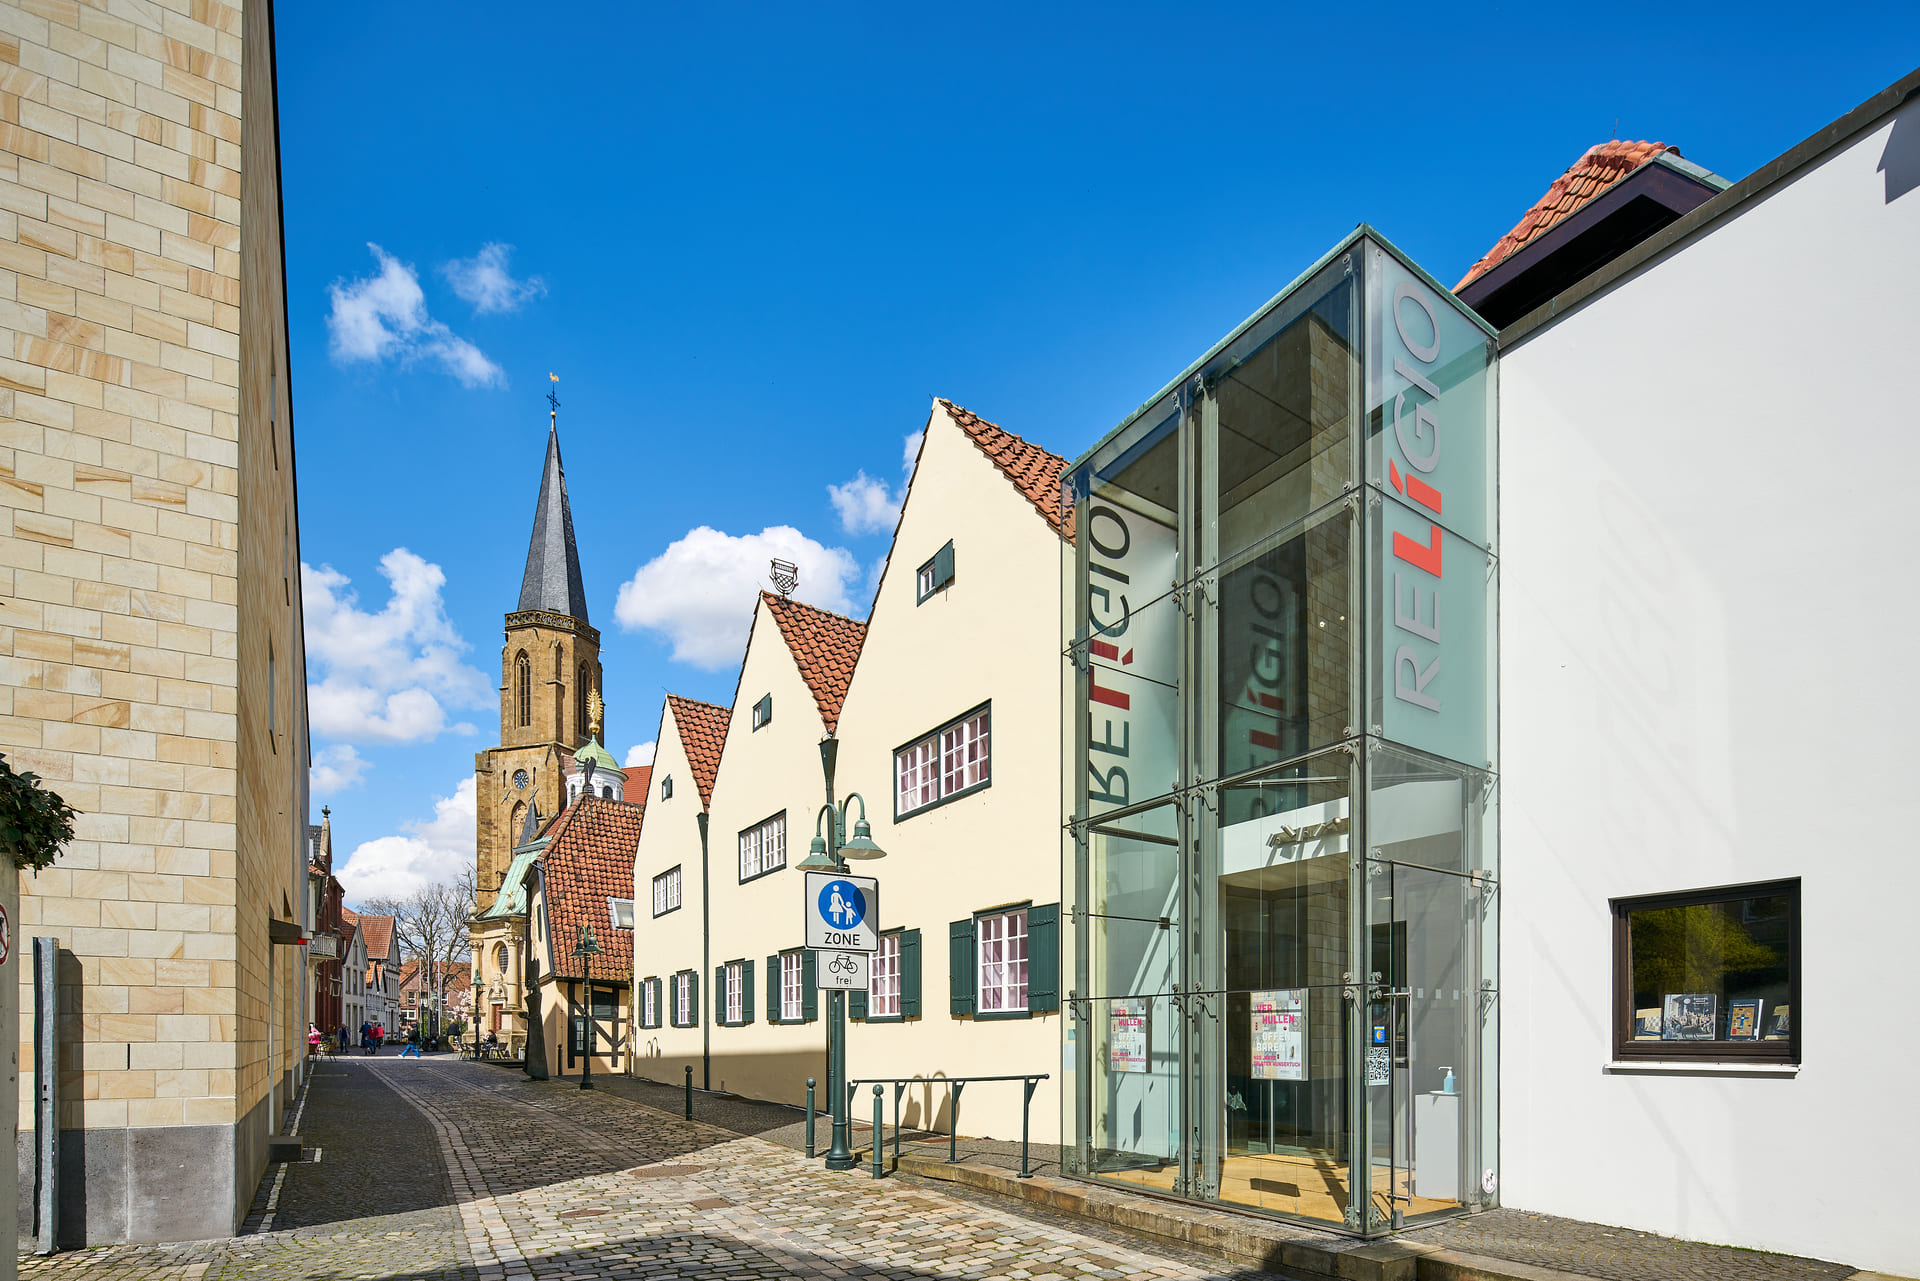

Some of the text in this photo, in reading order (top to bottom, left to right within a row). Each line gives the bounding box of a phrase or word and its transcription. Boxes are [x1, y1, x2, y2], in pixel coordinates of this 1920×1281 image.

[824, 932, 861, 946] ZONE
[836, 975, 852, 985] frei
[1256, 1004, 1273, 1013] VER
